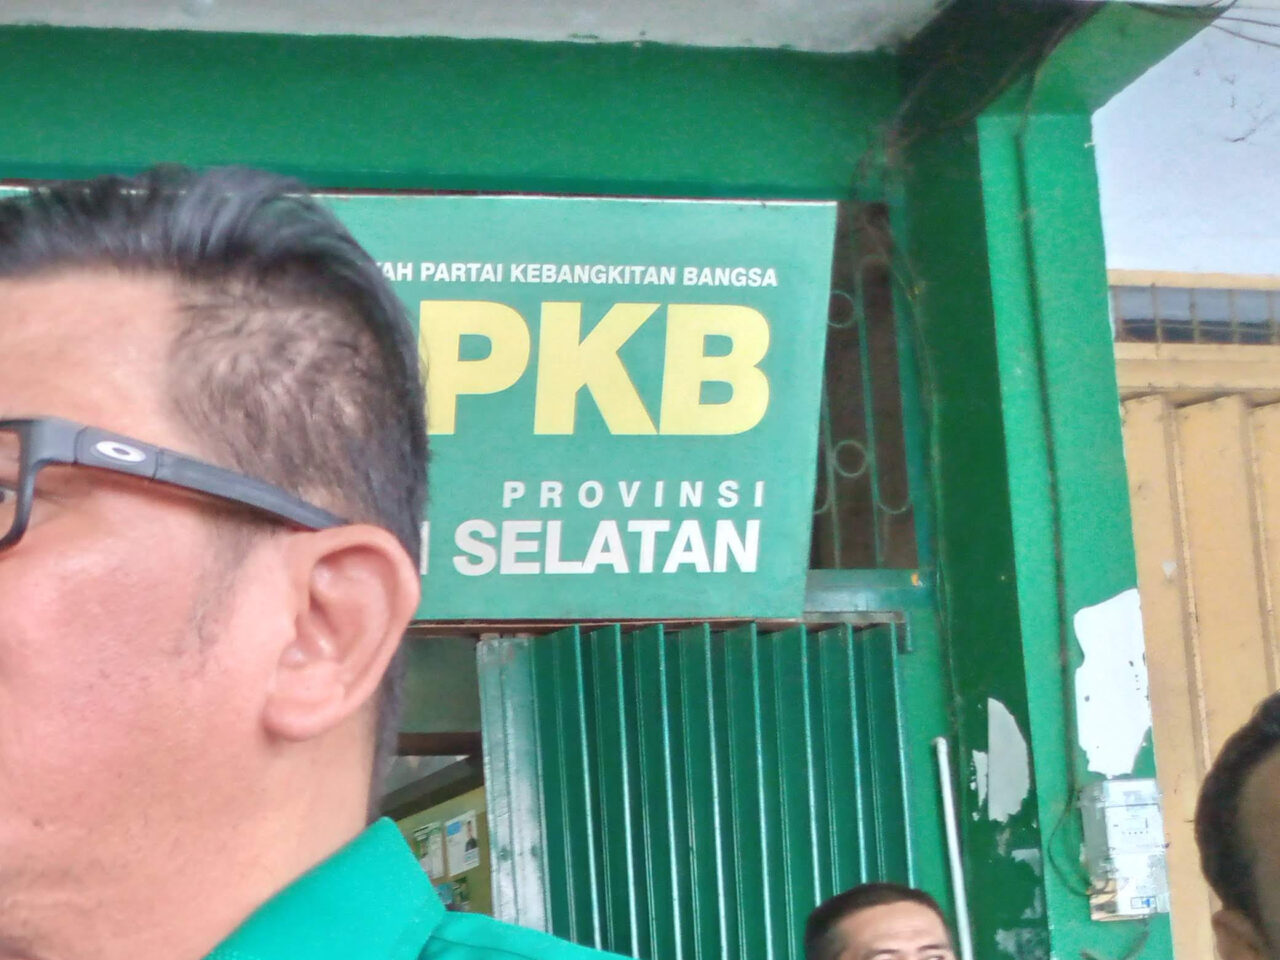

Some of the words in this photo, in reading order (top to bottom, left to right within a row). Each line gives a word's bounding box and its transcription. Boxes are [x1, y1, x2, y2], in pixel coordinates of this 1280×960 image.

[420, 263, 503, 283] PARTAI
[510, 264, 676, 285] KEBANGKITAN
[683, 267, 778, 287] BANGSA
[419, 299, 771, 435] PKB
[503, 480, 765, 508] PROVINSI
[452, 519, 761, 576] SELATAN
